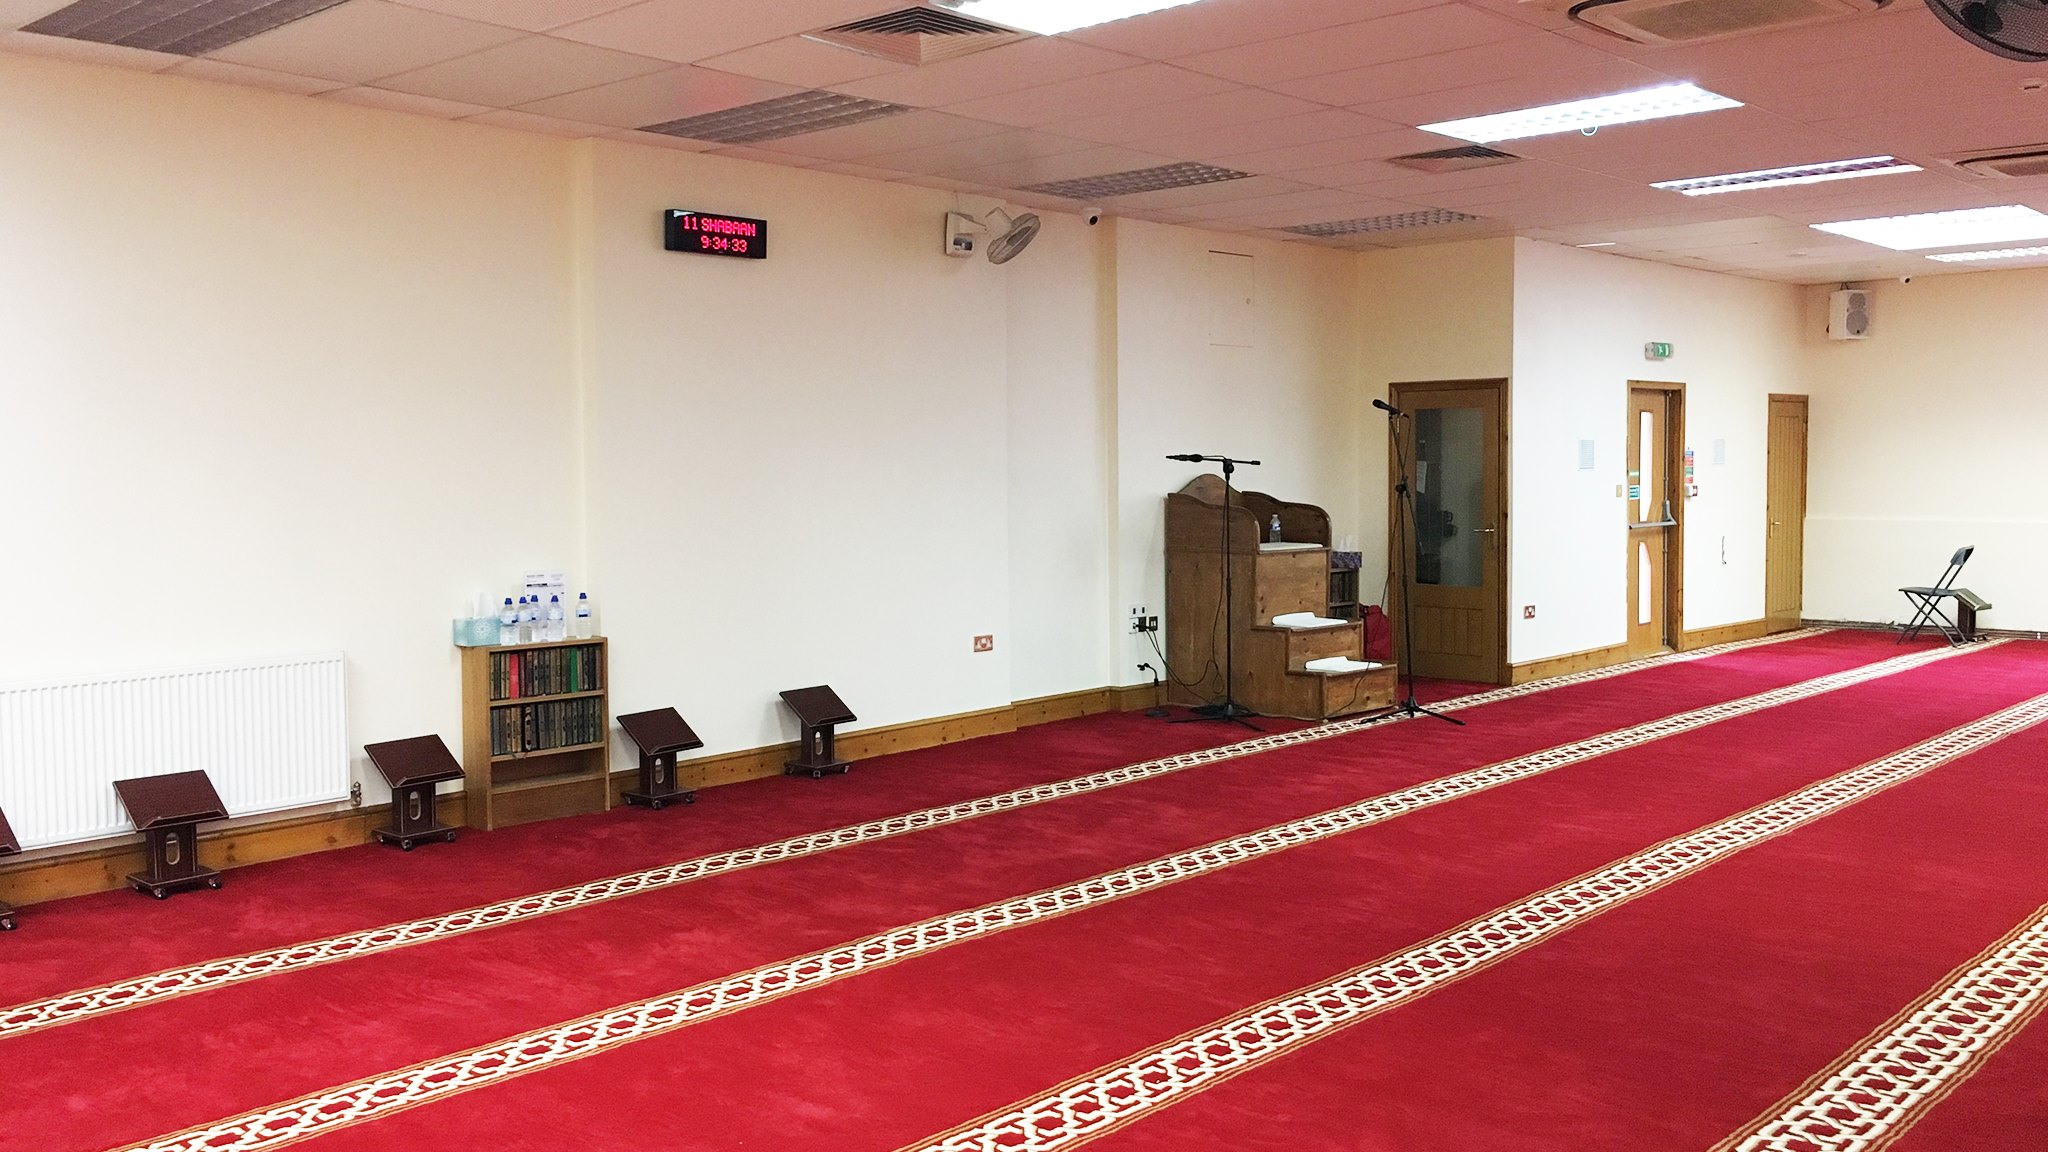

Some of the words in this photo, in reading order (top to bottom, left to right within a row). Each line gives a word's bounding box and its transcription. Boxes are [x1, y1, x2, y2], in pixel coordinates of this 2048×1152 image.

[684, 216, 698, 230] 11
[701, 218, 756, 237] SHABAAN
[701, 235, 747, 253] 9:34:33
